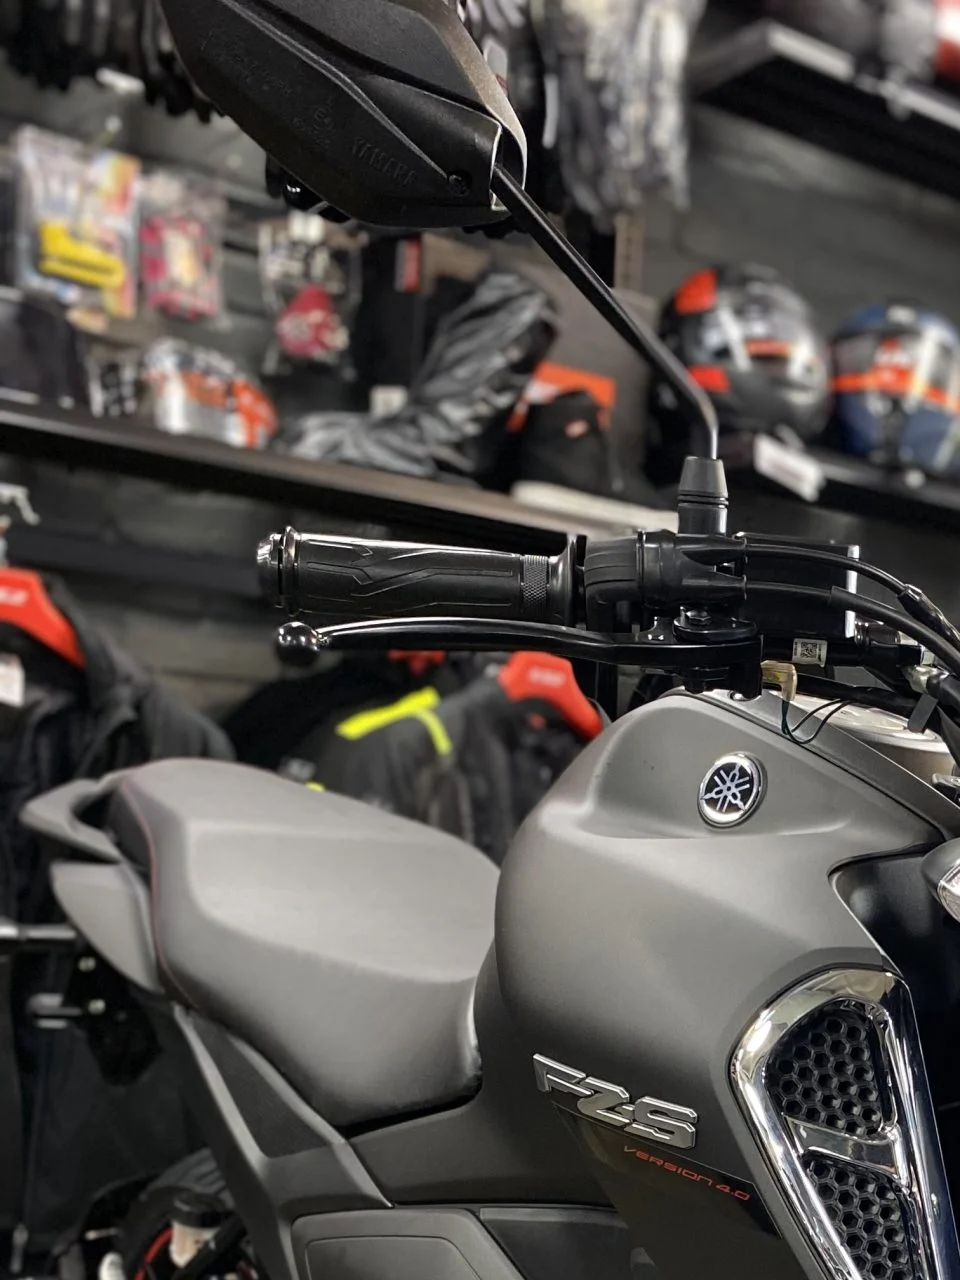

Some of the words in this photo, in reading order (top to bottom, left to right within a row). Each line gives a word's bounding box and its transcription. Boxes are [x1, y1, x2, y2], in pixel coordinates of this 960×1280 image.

[533, 1053, 698, 1149] FZS
[623, 1145, 712, 1187] VERSION
[716, 1183, 750, 1201] 4.0
